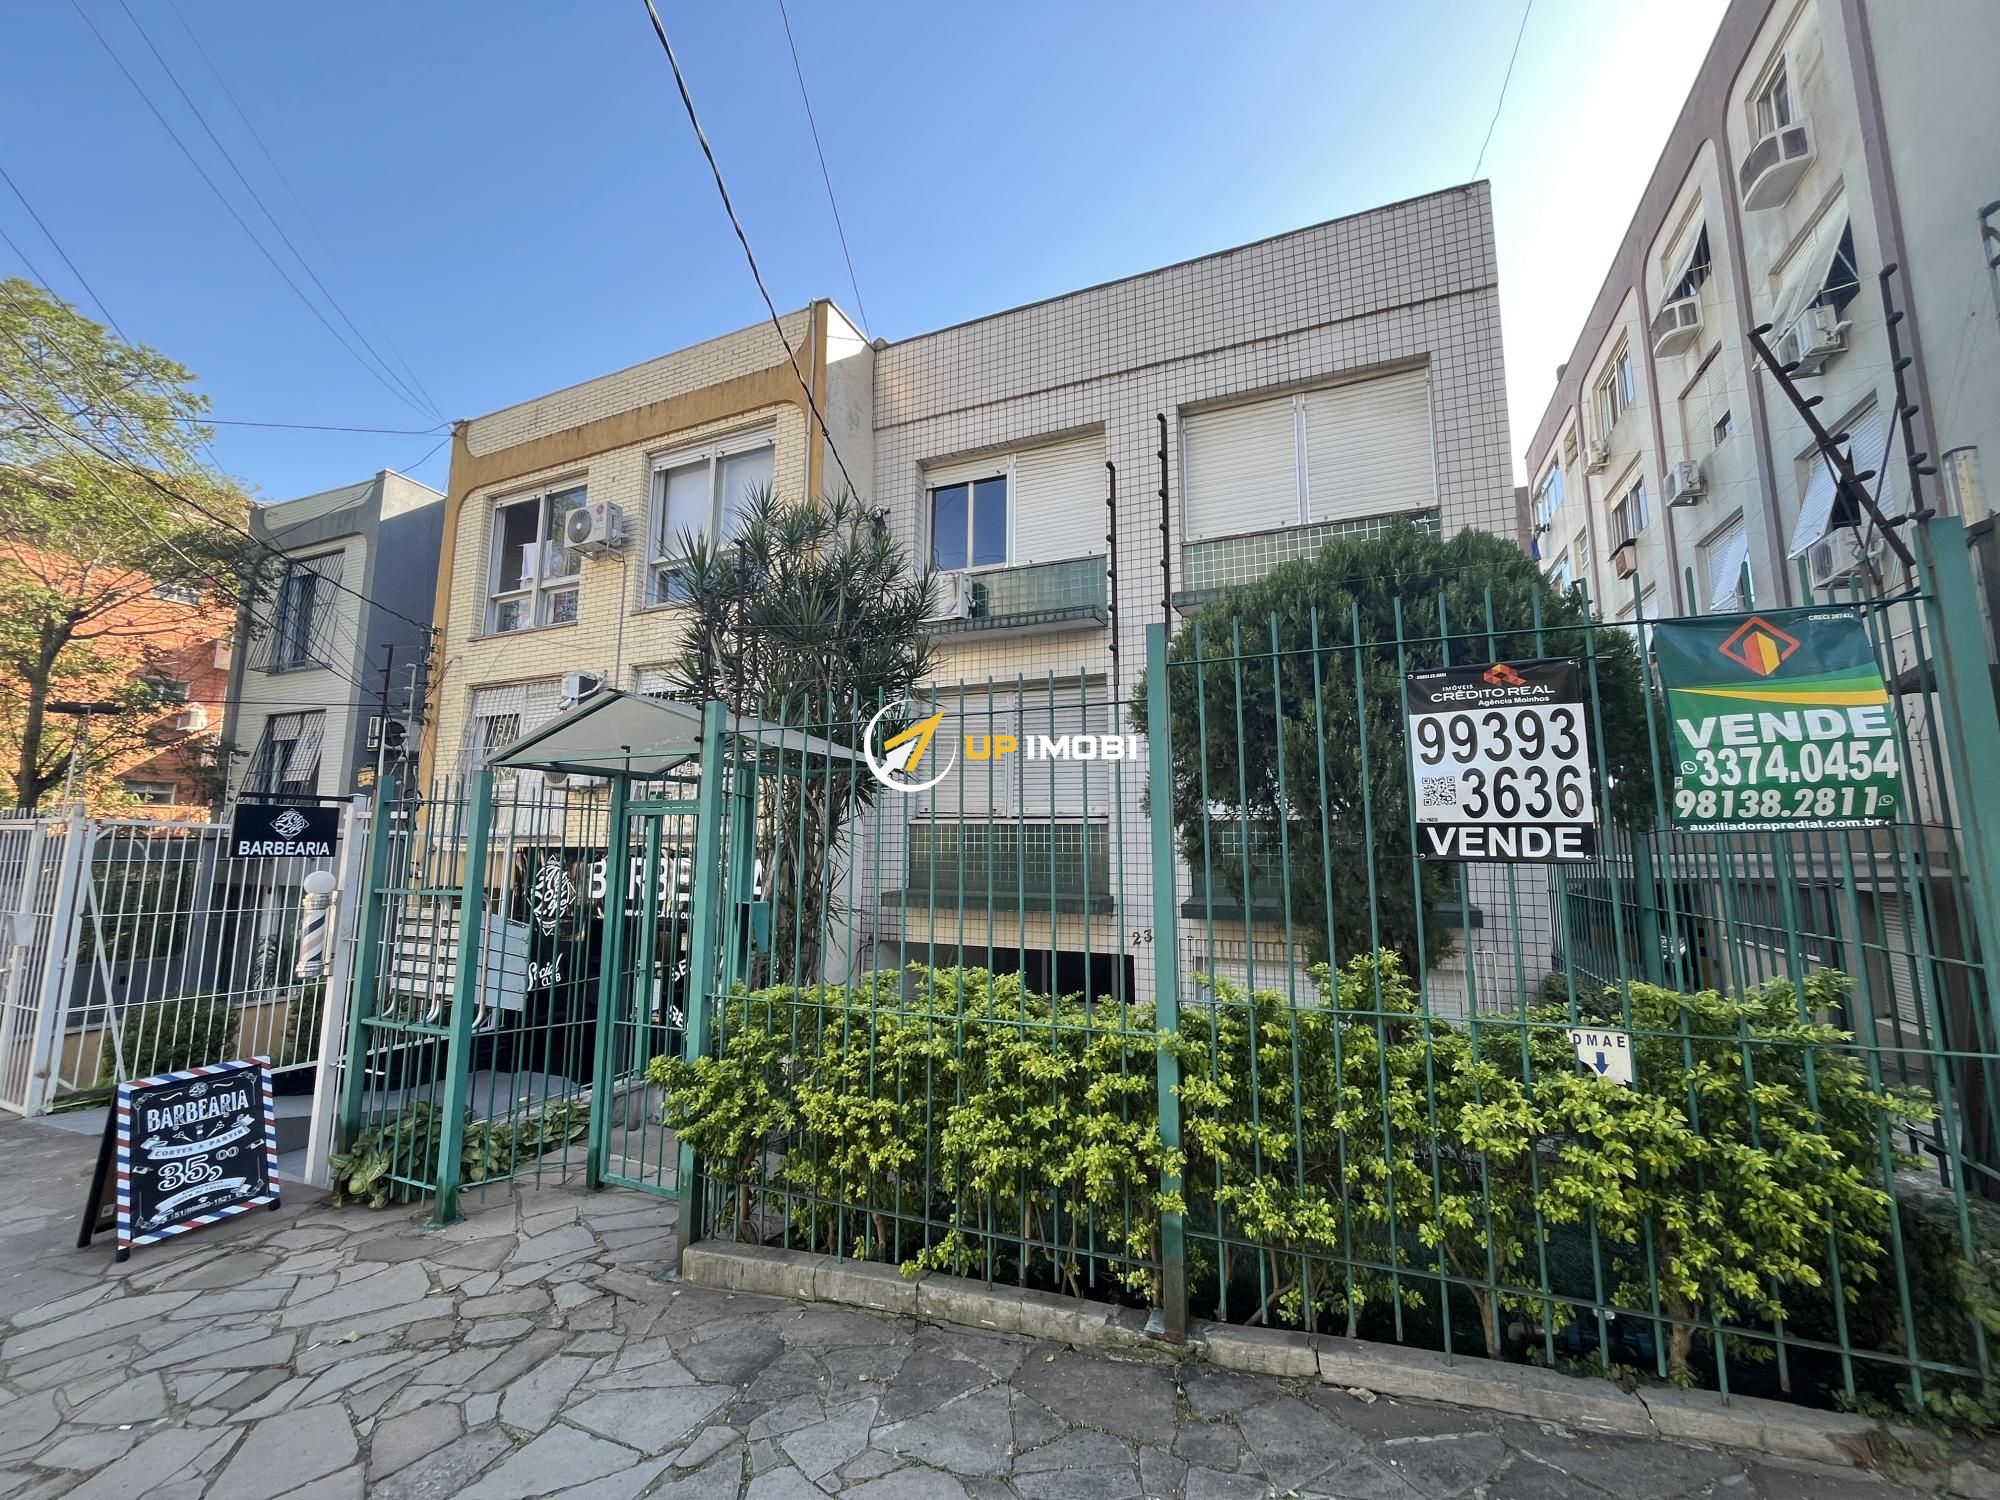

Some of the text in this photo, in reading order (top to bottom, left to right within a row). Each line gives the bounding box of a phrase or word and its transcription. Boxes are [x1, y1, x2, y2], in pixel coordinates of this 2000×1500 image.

[1430, 685, 1555, 703] CRÉDITO REAL
[1478, 695, 1550, 707] Agência Moinhos
[1417, 708, 1579, 765] 99393
[1676, 706, 1892, 748] VENDE
[1696, 739, 1898, 787] 3374.0454
[1462, 765, 1584, 818] 3636
[1675, 786, 1878, 818] 98138.2811
[1689, 817, 1882, 832] auxiliadorapredial.com.br
[238, 841, 330, 856] BARBEARIA
[1427, 827, 1585, 858] VENDE
[1573, 1033, 1626, 1048] DMAE
[147, 1089, 249, 1133] BARBEARIA
[155, 1147, 193, 1157] CORTES
[209, 1129, 244, 1147] PARTIR
